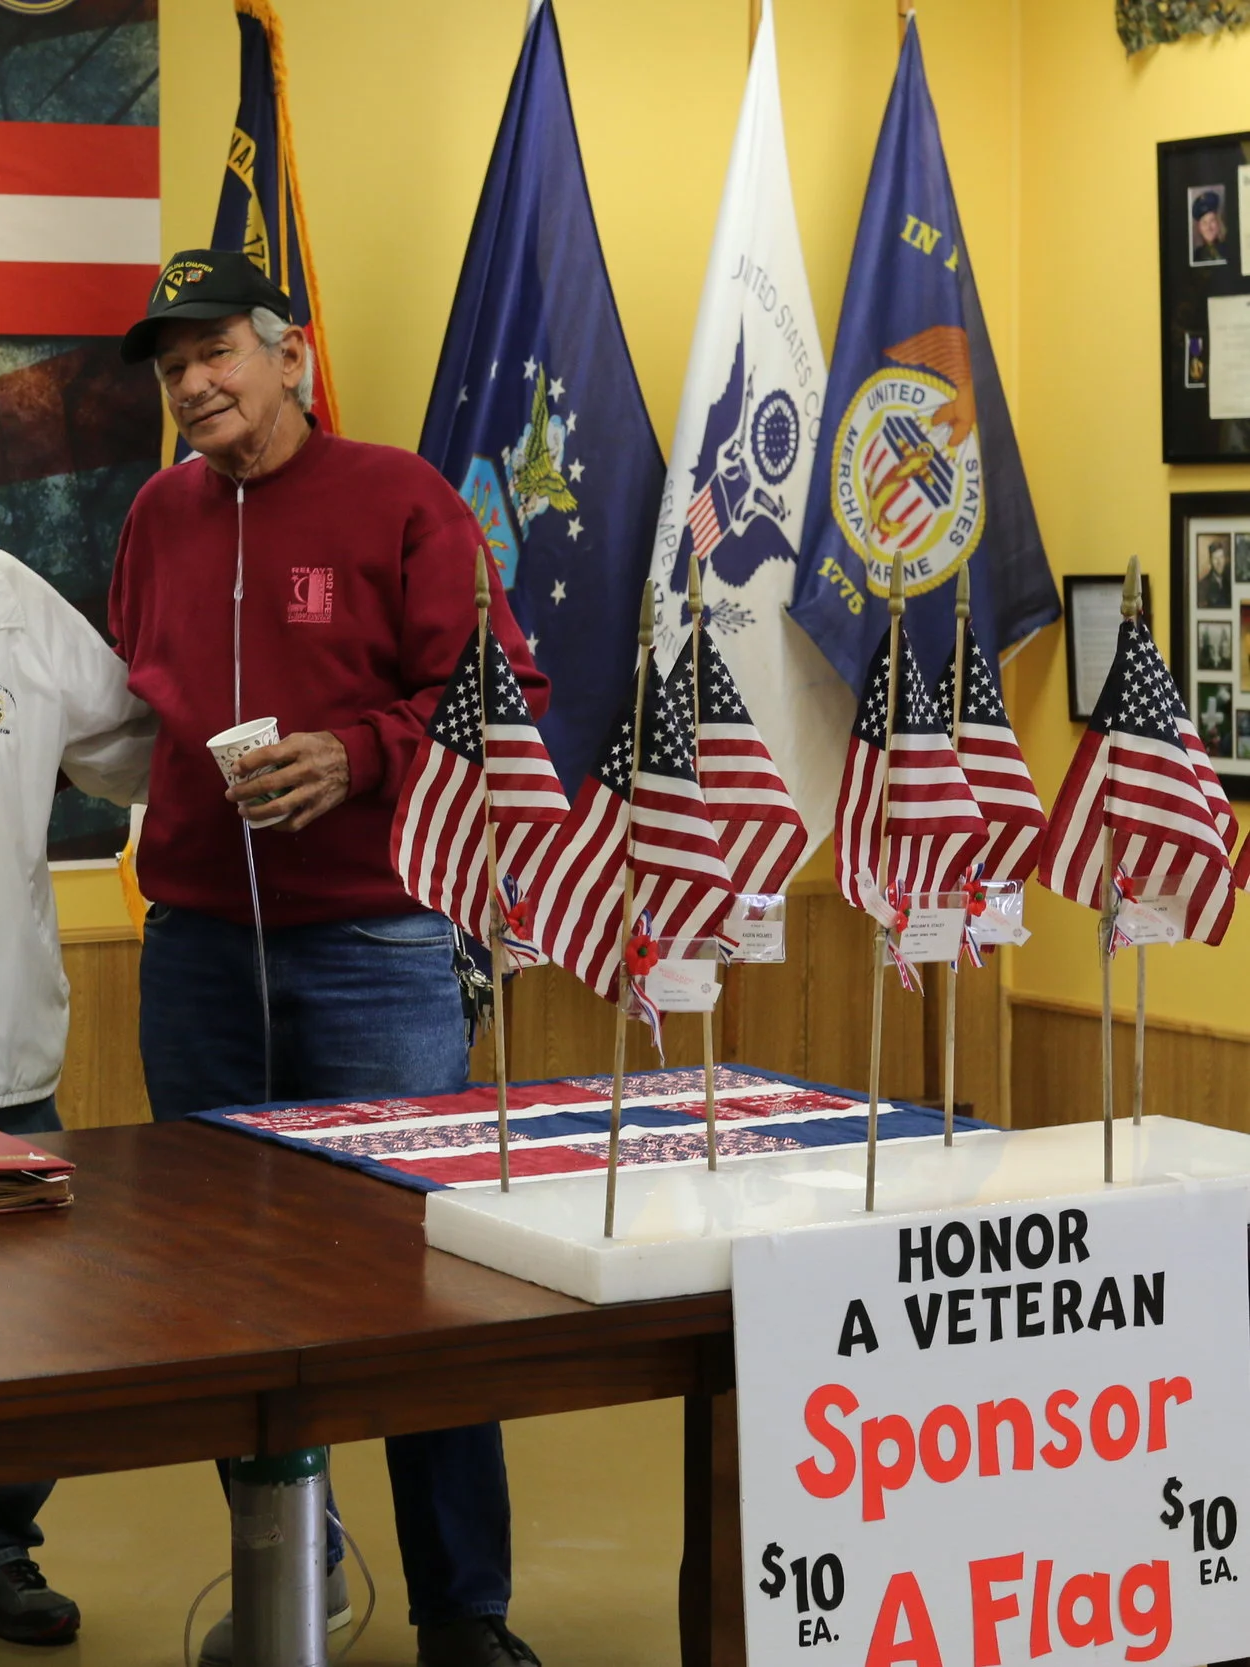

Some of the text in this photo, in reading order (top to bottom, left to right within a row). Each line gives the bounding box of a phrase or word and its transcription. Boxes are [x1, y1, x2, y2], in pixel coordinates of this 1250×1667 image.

[185, 261, 214, 273] CHAPTER
[901, 213, 942, 255] IN
[775, 304, 813, 388] STATES
[804, 391, 822, 444] CO
[867, 382, 980, 546] UNITED STATES
[291, 566, 326, 575] RELAY
[326, 567, 334, 590] FOR
[817, 557, 866, 616] 1775
[867, 557, 933, 582] MARNE
[898, 1208, 1091, 1283] HONOR
[837, 1271, 1166, 1358] A VETERAN
[795, 1375, 1193, 1523] Sponsor
[1160, 1476, 1238, 1552] $10
[758, 1541, 845, 1615] $10
[1199, 1556, 1239, 1586] EA.
[798, 1615, 841, 1648] EA.
[864, 1551, 1173, 1667] A Flag
